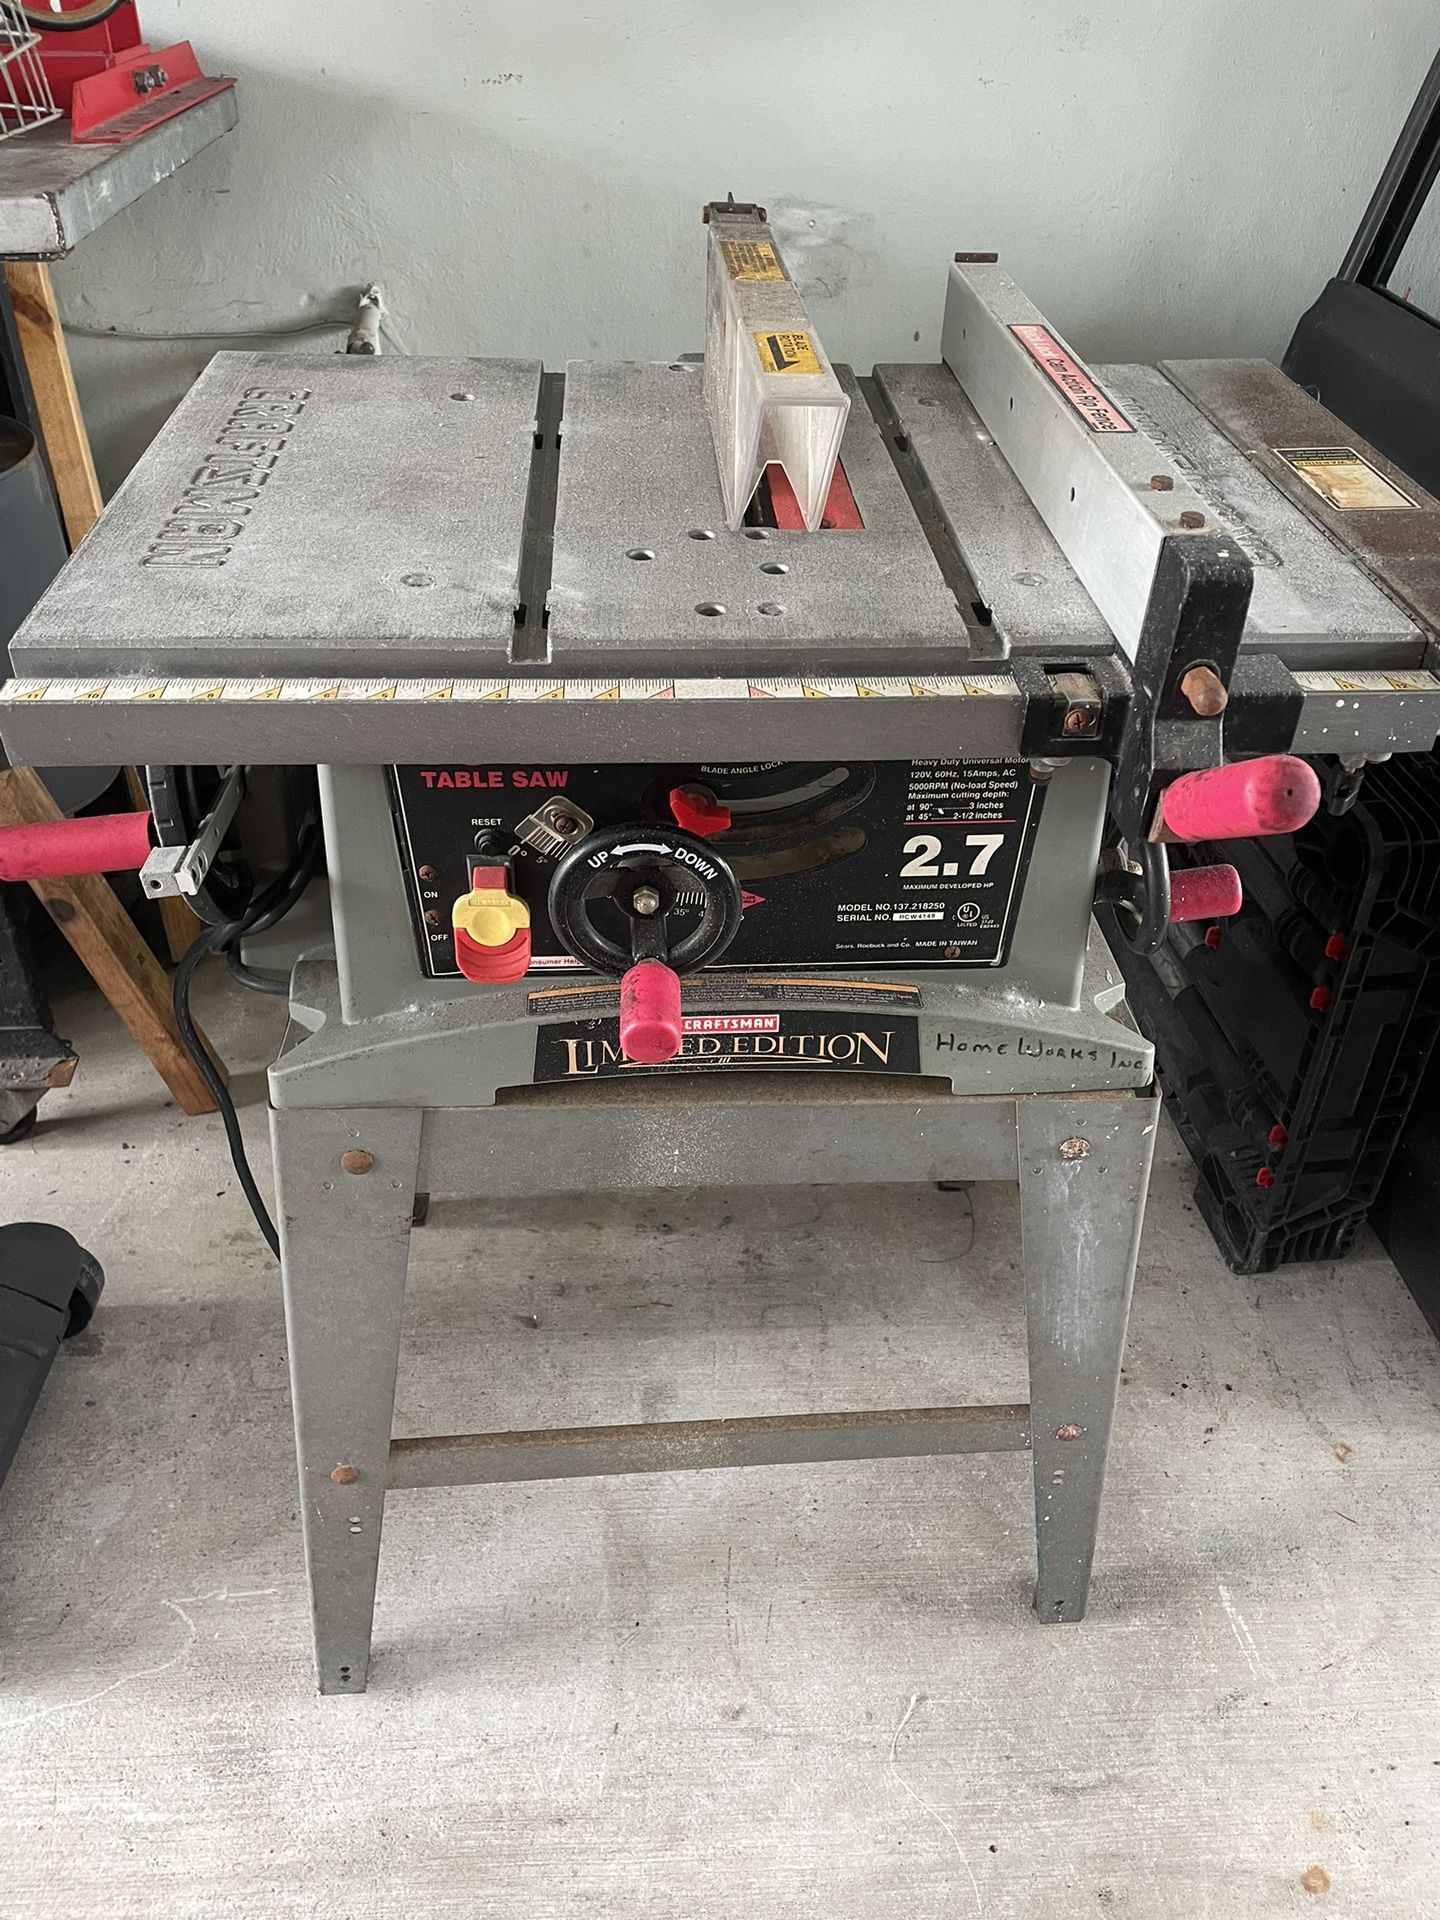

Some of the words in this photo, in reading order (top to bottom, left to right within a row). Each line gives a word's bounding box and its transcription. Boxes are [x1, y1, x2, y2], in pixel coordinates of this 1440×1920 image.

[791, 334, 809, 351] BLADE
[1046, 358, 1068, 376] Cam
[1061, 373, 1088, 395] Action
[1076, 395, 1099, 410] Rip
[1087, 408, 1118, 430] Fence
[140, 387, 312, 569] CRAFTSMAN
[911, 758, 938, 767] Heavy
[940, 758, 960, 767] Duty
[962, 757, 1003, 765] Universal
[1004, 757, 1029, 765] Motor
[700, 765, 728, 775] BLADE
[730, 765, 759, 774] ANGLE
[1002, 768, 1017, 777] AC
[421, 772, 504, 788] TABLE
[512, 771, 569, 787] SAW
[908, 782, 949, 791] 5000RPM
[950, 781, 987, 791] (No-load
[988, 780, 1019, 790] Speed)
[908, 792, 949, 800] Maximum
[951, 792, 980, 800] cutting
[982, 791, 1010, 800] depth:
[906, 803, 915, 811] at
[976, 801, 1004, 809] inches
[975, 811, 1003, 819] inches
[471, 818, 502, 827] RESET
[587, 851, 610, 870] UP
[899, 833, 1005, 877] 2.7
[674, 848, 719, 881] DOWN
[903, 883, 938, 891] MAXIMUM
[939, 882, 982, 890] DEVELOPED
[423, 891, 438, 899] ON
[837, 904, 873, 912] MODEL
[836, 914, 873, 922] SERIAL
[874, 913, 892, 921] NO.
[430, 933, 449, 942] OFF
[684, 1018, 776, 1031] CRAFTSMAN
[558, 1036, 721, 1075] LIMED
[734, 1031, 895, 1065] EDITION
